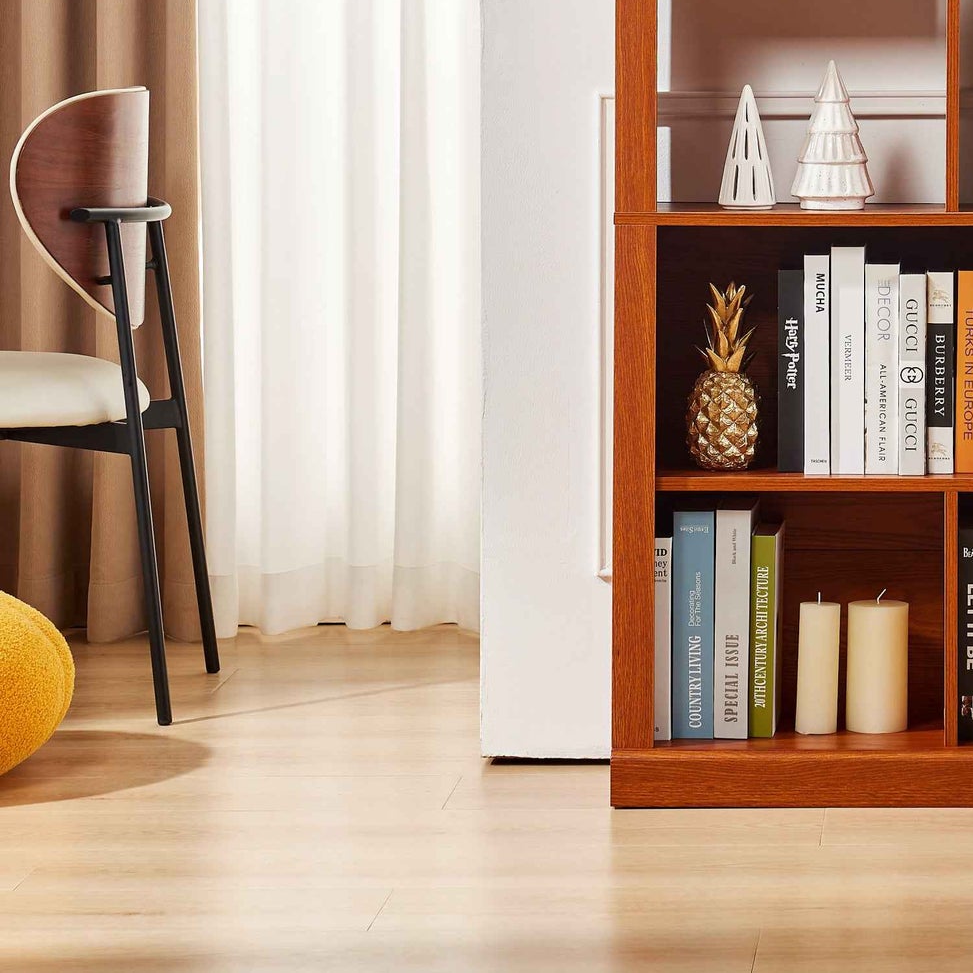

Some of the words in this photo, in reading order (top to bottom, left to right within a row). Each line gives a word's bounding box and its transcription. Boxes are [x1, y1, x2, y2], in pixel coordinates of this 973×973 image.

[815, 273, 826, 313] MUCHA
[877, 285, 891, 341] DECOR
[784, 317, 800, 353] Harry
[905, 299, 919, 352] GUCCI
[781, 353, 800, 390] Potter
[844, 334, 853, 382] VERMEER
[935, 334, 946, 417] BURBERRY
[879, 364, 887, 433] ALL-AMERICAN
[963, 380, 973, 440] EUROPE
[878, 436, 887, 461] FLAIR
[905, 398, 918, 452] GUCCI
[688, 590, 696, 626] Decorating
[688, 635, 702, 674] LIVING
[725, 634, 739, 667] ISSUE
[688, 675, 702, 728] COUNTRY
[724, 674, 739, 722] SPECIAL
